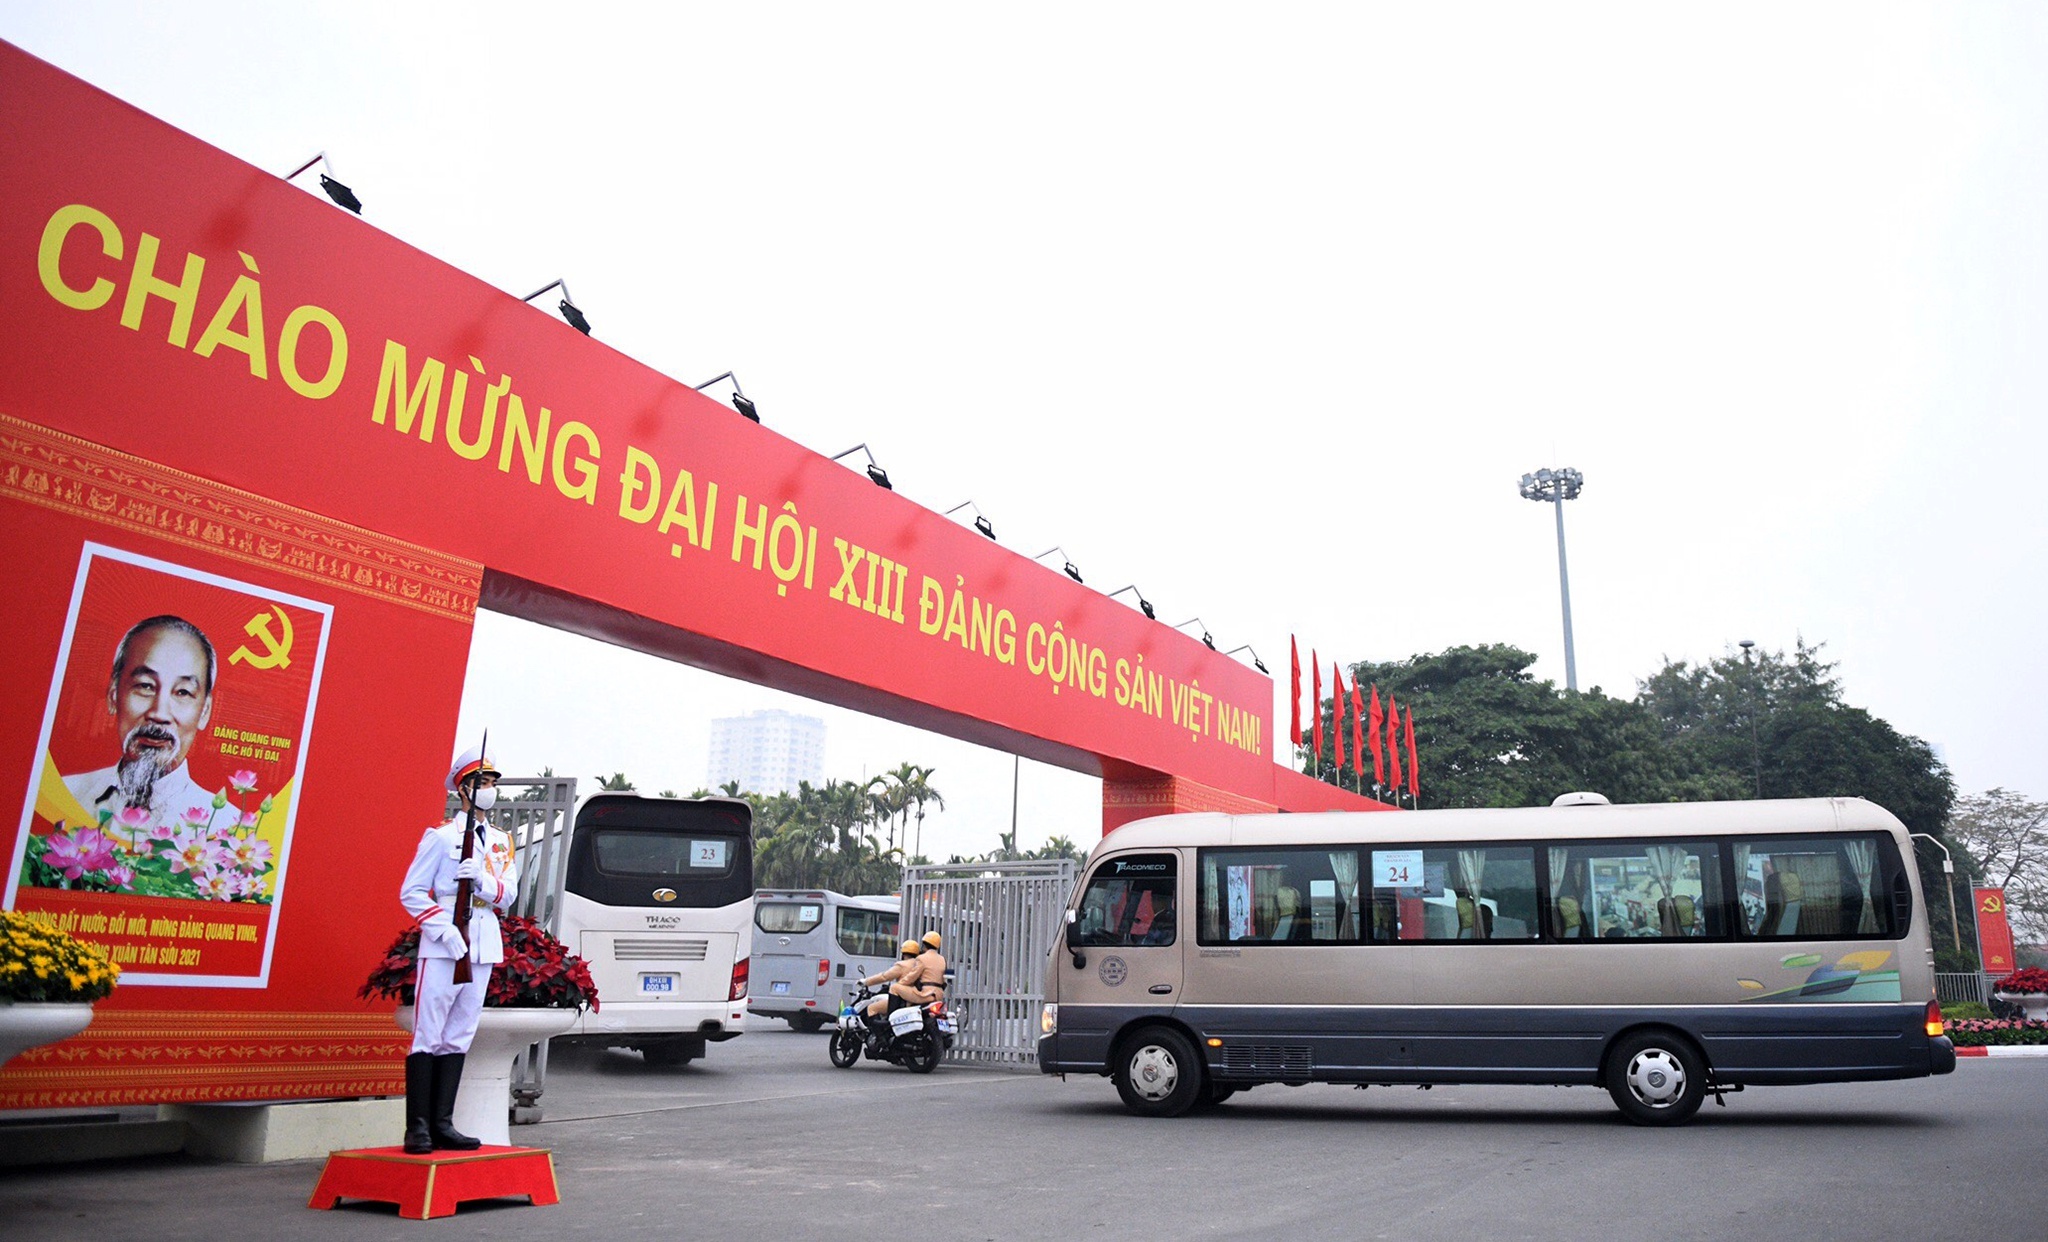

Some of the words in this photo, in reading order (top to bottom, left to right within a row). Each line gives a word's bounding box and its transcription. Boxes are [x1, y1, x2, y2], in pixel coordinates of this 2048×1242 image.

[39, 204, 348, 399] CHÀO
[372, 340, 601, 506] MỪNG
[620, 447, 717, 559] ĐẠI
[732, 495, 817, 597] HỘI
[829, 537, 909, 624] XIII
[919, 574, 1016, 664] ĐẢNG
[1026, 620, 1106, 697] CỘNG
[1114, 652, 1163, 718] SẢN
[1170, 680, 1213, 743] VIỆT
[1218, 700, 1261, 755] NAM!
[213, 725, 239, 740] ĐẢNG
[240, 731, 270, 746] QUANG
[270, 736, 292, 749] VINH
[220, 742, 239, 755] BÁC
[264, 750, 280, 763] ĐẠI
[701, 849, 715, 860] 23
[1114, 861, 1166, 874] TRACOMECO
[1389, 866, 1409, 882] 24
[59, 908, 79, 931] ĐẤT
[79, 911, 108, 934] NƯỚC
[108, 911, 127, 935] ĐỔI
[127, 913, 147, 937] MỚI,
[150, 916, 178, 937] MỪNG
[178, 915, 205, 938] ĐẢNG
[205, 922, 235, 941] QUANG
[236, 924, 258, 943] VINH,
[110, 942, 138, 964] XUÂN
[139, 943, 158, 964] TÂN
[158, 941, 178, 966] SỬU
[178, 949, 201, 966] 2021
